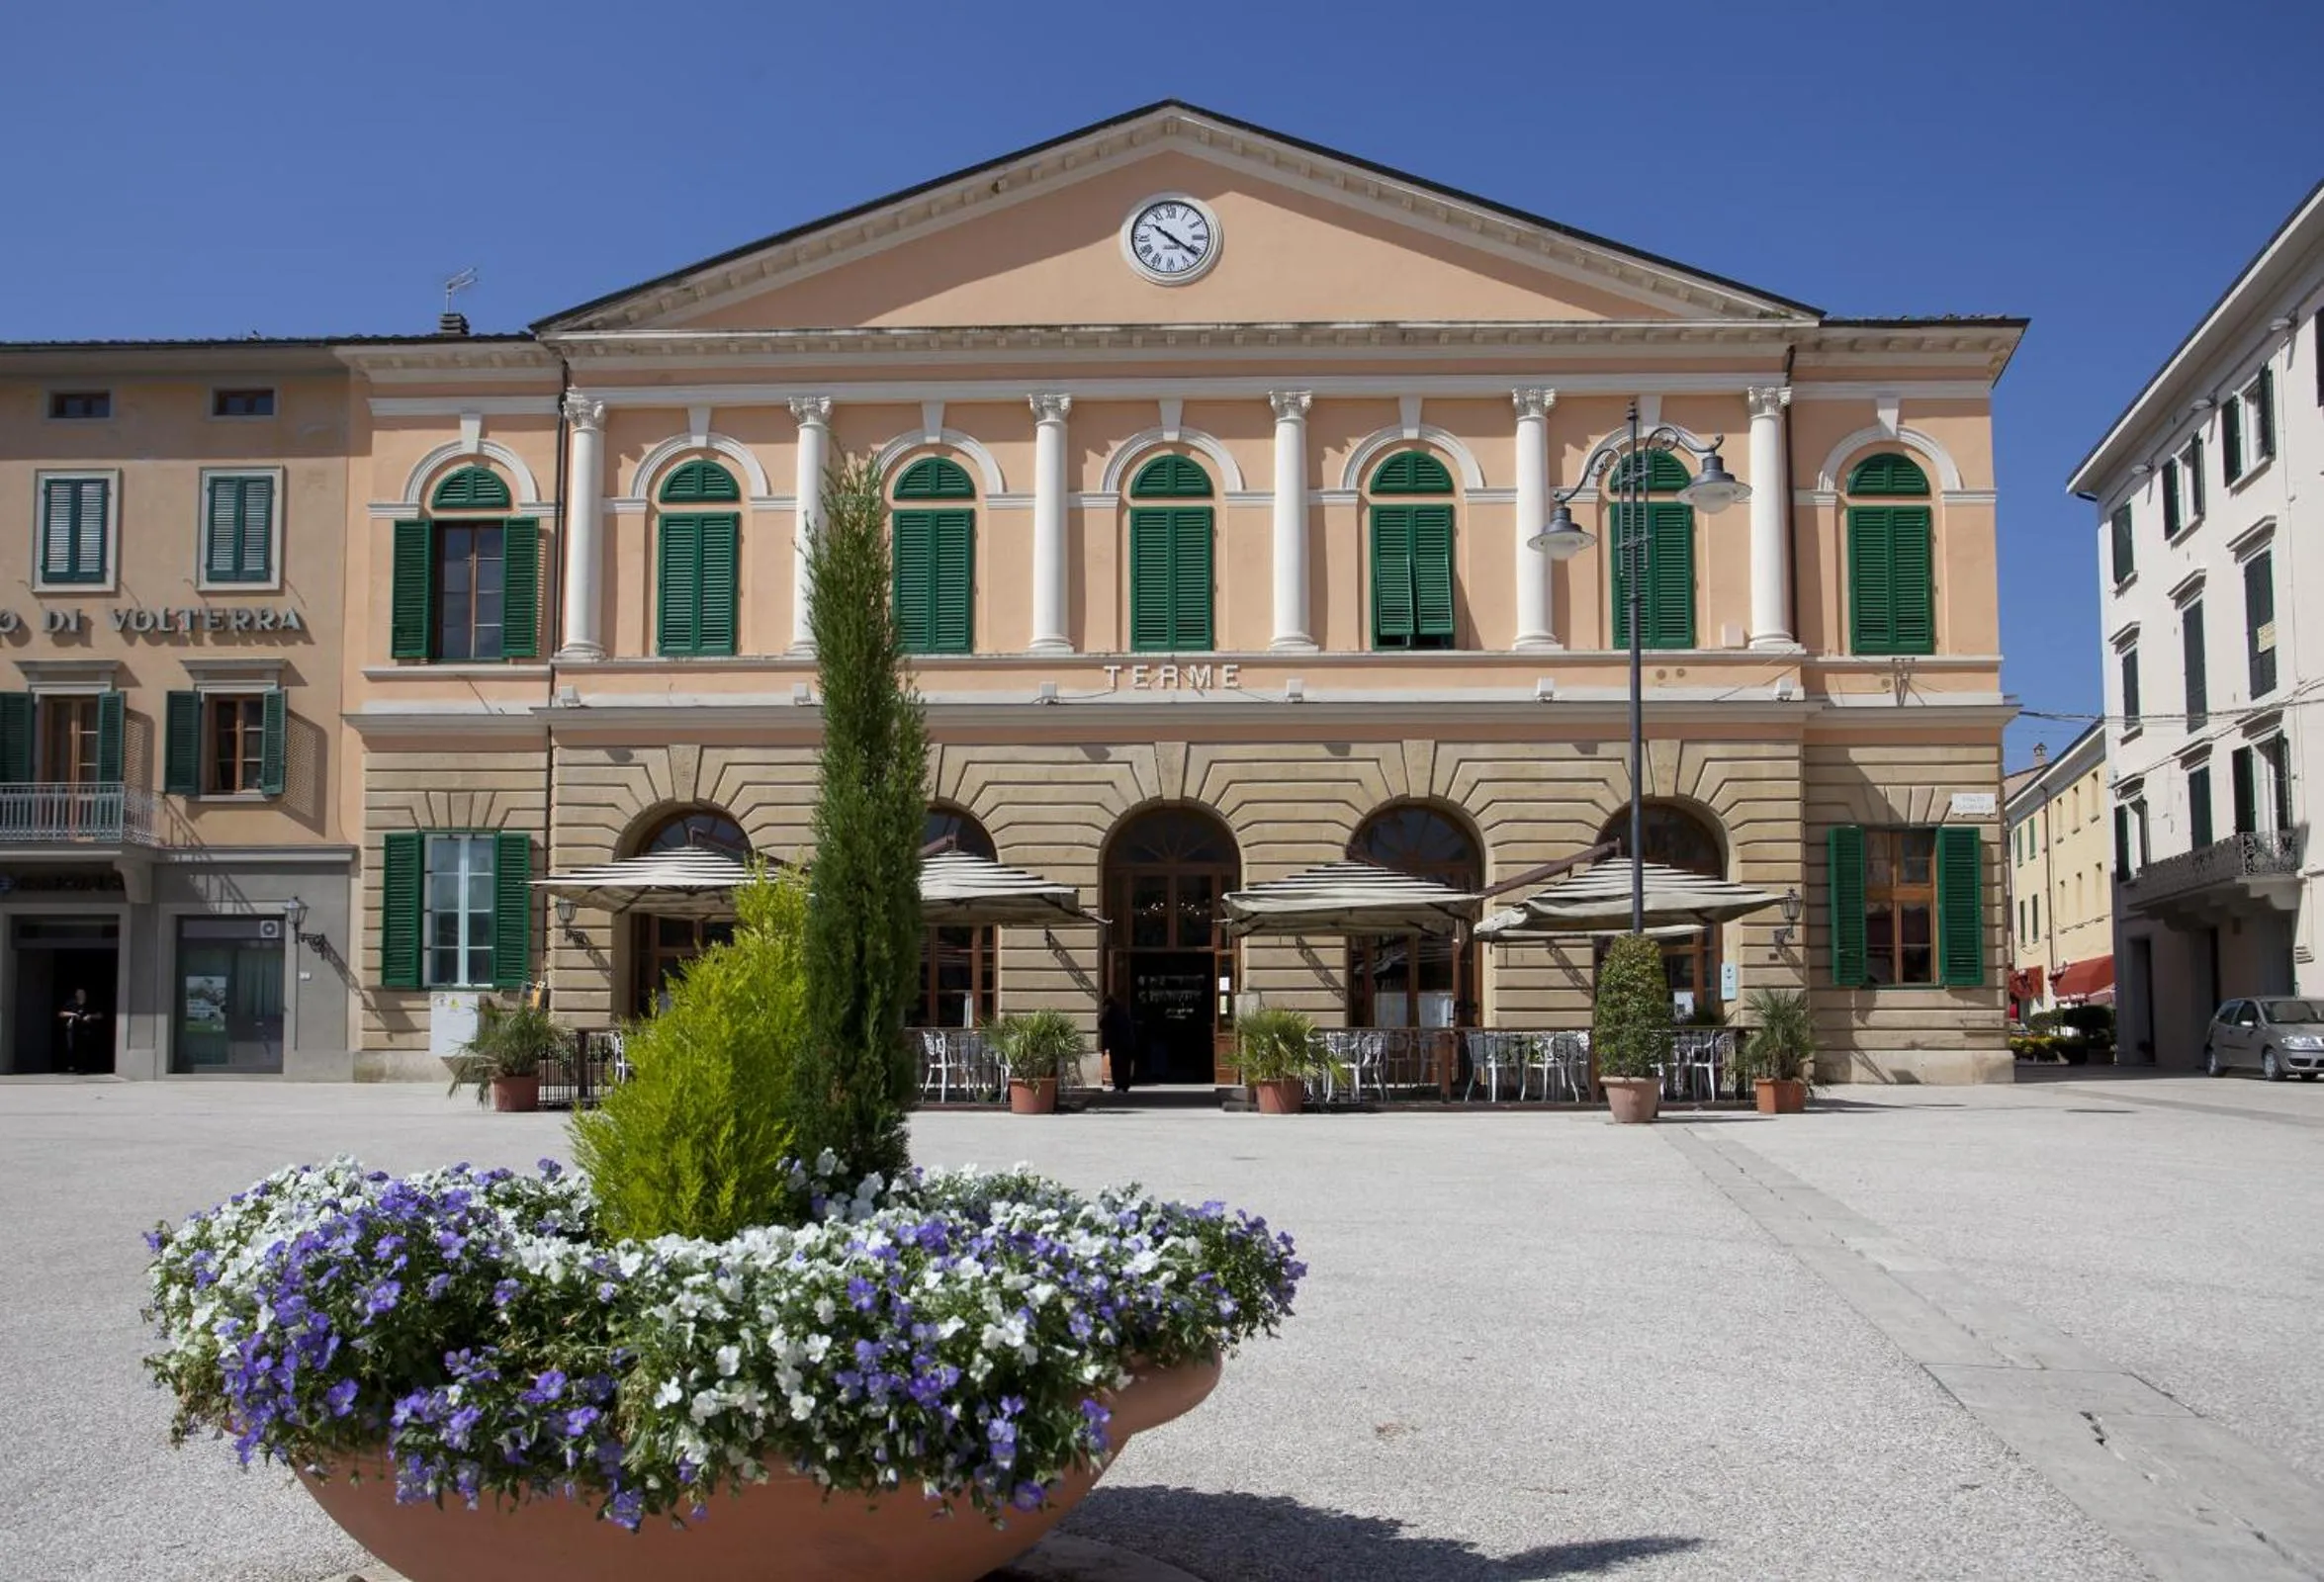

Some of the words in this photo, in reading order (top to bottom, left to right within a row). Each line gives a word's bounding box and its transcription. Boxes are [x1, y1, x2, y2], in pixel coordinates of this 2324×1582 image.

[44, 608, 81, 633] DI
[111, 606, 303, 633] VOLTERRA
[1103, 664, 1242, 689] TERME
